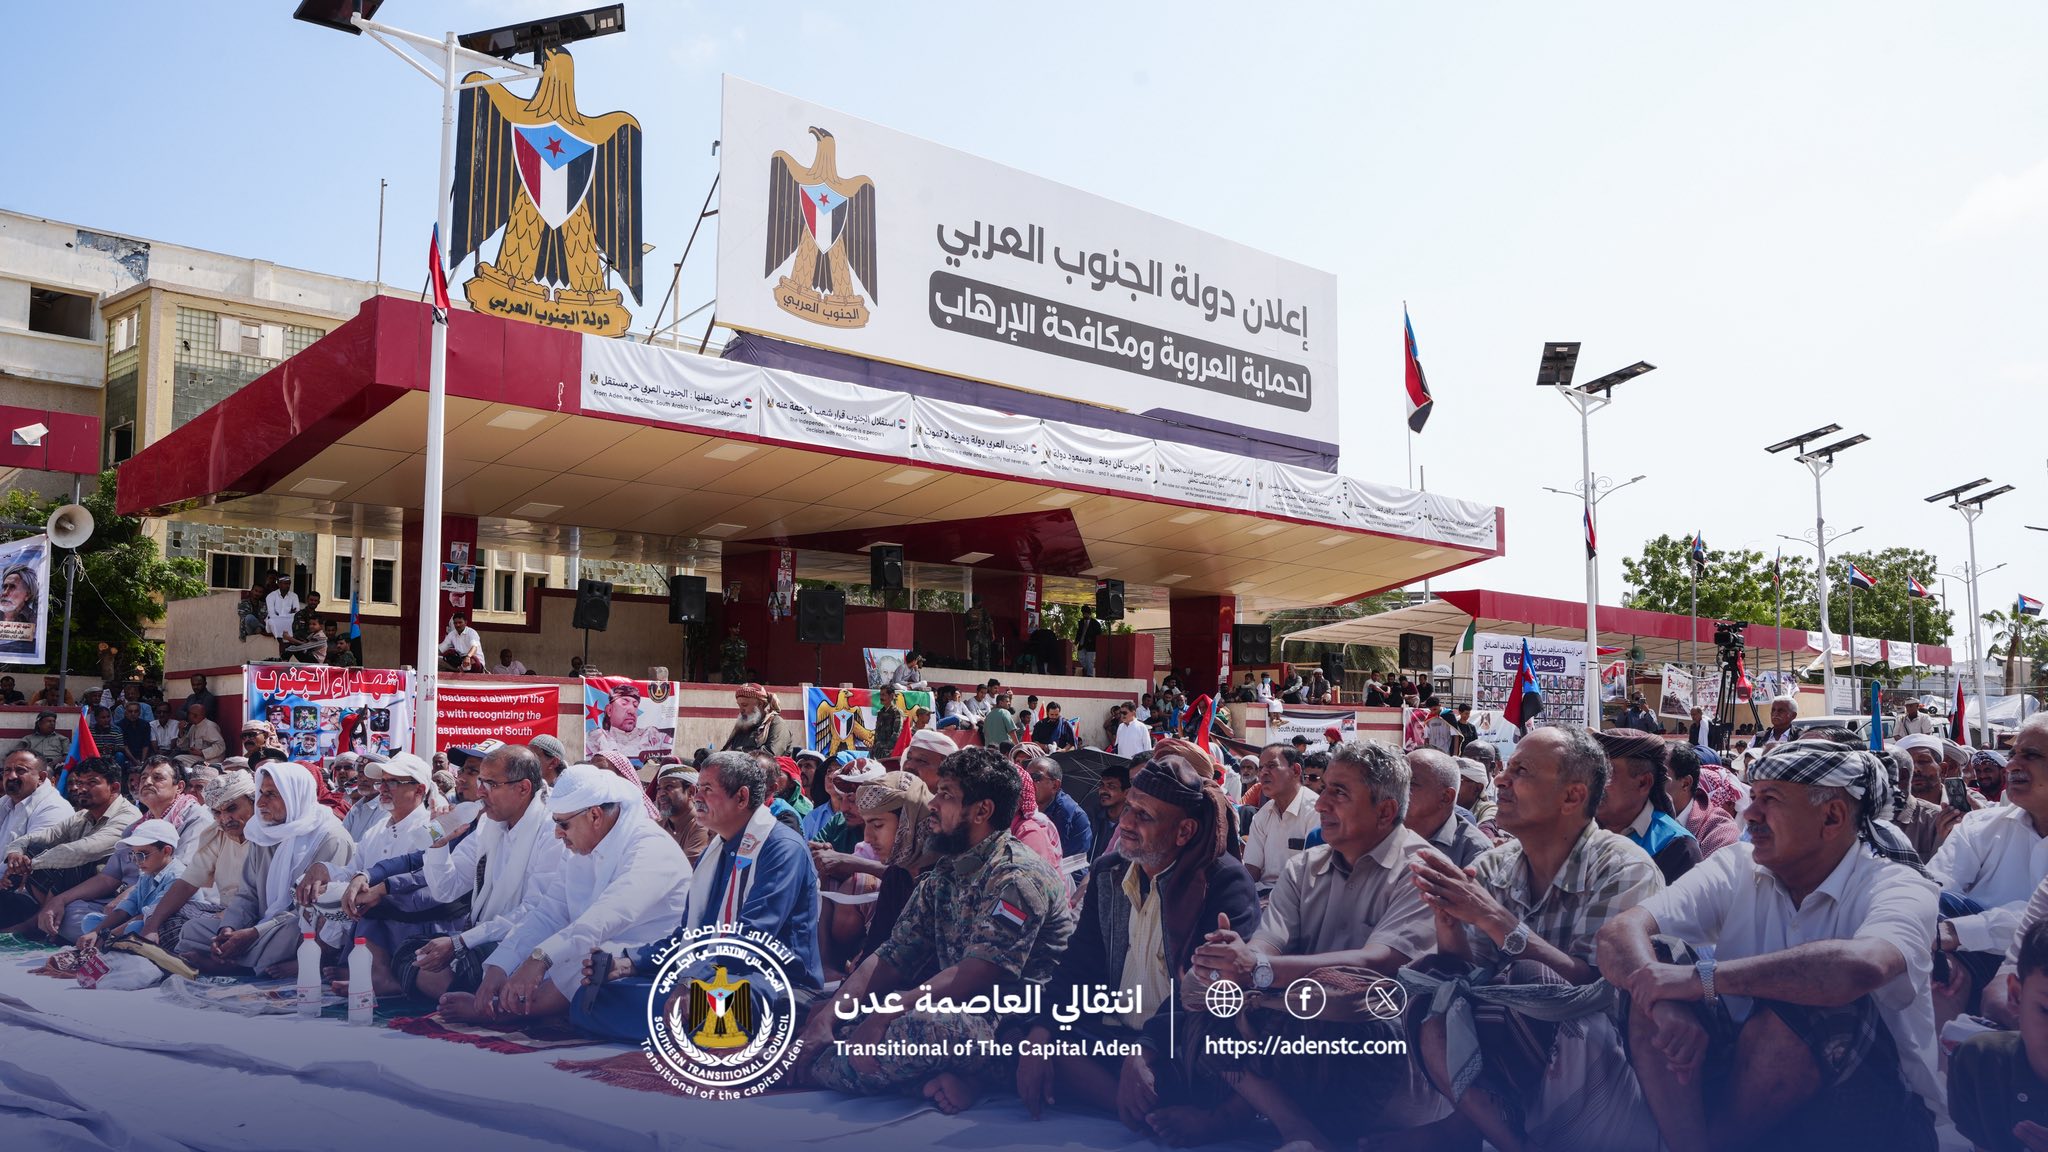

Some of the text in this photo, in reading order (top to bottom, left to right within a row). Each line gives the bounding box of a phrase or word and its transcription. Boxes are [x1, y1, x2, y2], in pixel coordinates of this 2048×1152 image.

[936, 220, 1308, 351] إعلان دولة الجنوب العربي
[488, 296, 610, 329] دولة الجنوب العربي
[783, 294, 860, 322] الجنوب العربي
[934, 287, 1308, 399] لحماية العروبة ومكافحة الإرهاب
[601, 375, 742, 408] من عدن نعلنها الجنوب العربي حر مستقل
[593, 389, 608, 397] From
[656, 399, 671, 407] South
[671, 402, 689, 410] Arabia
[694, 405, 705, 413] free
[716, 410, 748, 419] independent
[775, 401, 788, 409] عنه
[807, 405, 813, 414] لا
[814, 408, 833, 418] شعب
[834, 409, 846, 421] قرار
[799, 418, 832, 428] independe
[846, 415, 870, 425] الجنوب
[871, 416, 896, 428] استقلال
[924, 428, 943, 439] تموت
[944, 431, 950, 439] لا
[971, 435, 986, 447] دولة
[986, 439, 1005, 452] العربي
[1005, 443, 1029, 454] الجنوب
[1053, 448, 1143, 474] الجنوب كان دولة وسيعود دولة
[1542, 656, 1560, 667] مكافحة
[255, 667, 330, 700] الجنوب
[439, 693, 545, 705] leaders: stability in the
[446, 709, 468, 719] with
[469, 710, 525, 721] recognizing
[526, 710, 541, 720] the
[437, 726, 533, 737] aspirations of South
